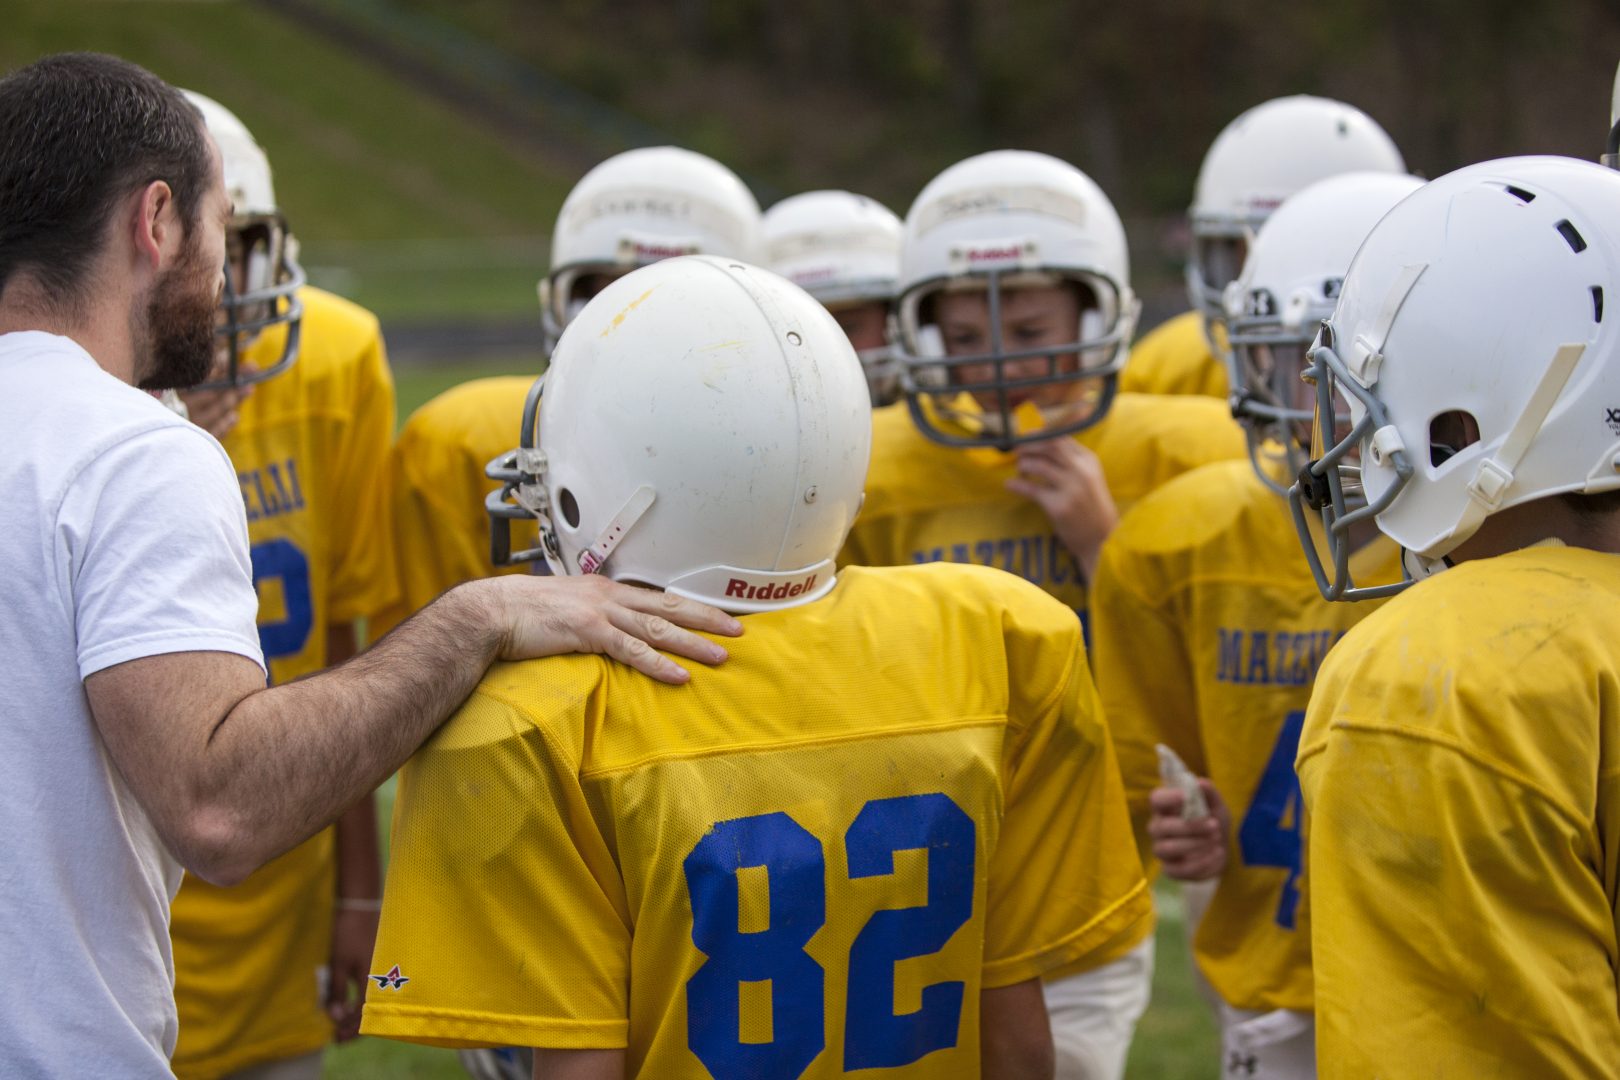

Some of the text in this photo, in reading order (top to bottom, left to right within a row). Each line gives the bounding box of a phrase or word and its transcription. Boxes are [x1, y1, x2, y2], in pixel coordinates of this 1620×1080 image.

[725, 574, 817, 600] Riddell
[1217, 627, 1346, 686] MAZZU
[682, 791, 976, 1080] 82
